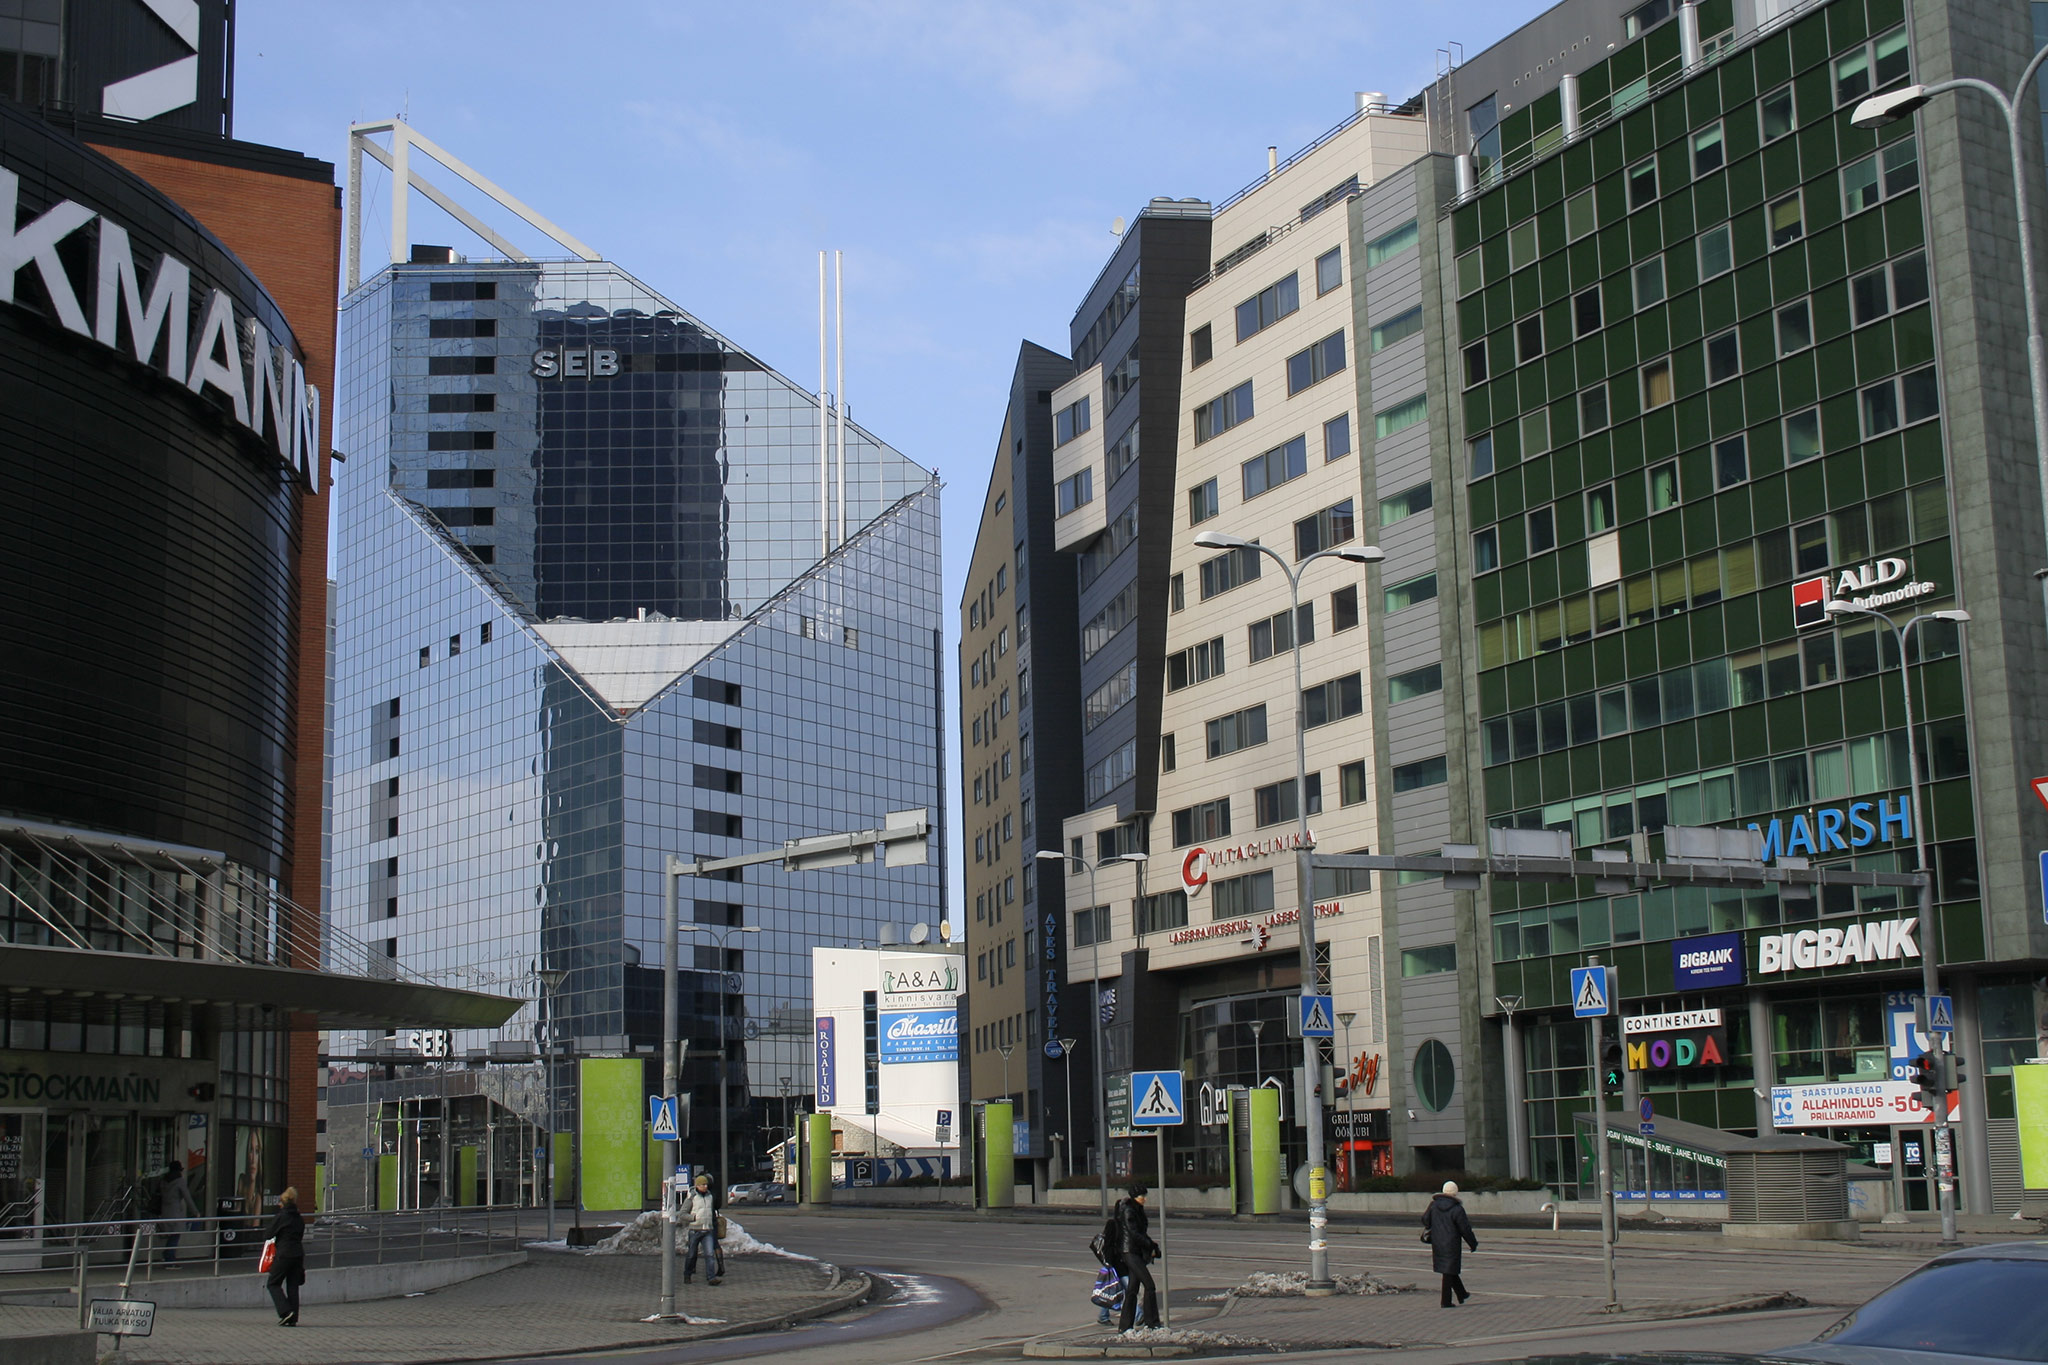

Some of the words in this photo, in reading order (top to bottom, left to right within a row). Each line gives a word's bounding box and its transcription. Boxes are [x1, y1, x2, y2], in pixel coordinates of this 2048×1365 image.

[534, 350, 619, 378] SEB
[1836, 557, 1907, 595] ALD
[1852, 581, 1935, 609] Automotive
[1747, 794, 1914, 862] MARSH
[1209, 829, 1316, 866] VITACLINIKA
[1264, 902, 1343, 926] LASERCTRUM
[1045, 913, 1056, 959] AVES
[1169, 919, 1251, 943] LASERRAVIKESKUS
[1759, 917, 1920, 973] BIGBANK
[1679, 948, 1733, 968] BIGBANK
[885, 993, 957, 1003] kinnisvara
[1046, 969, 1058, 1040] TRAVEL
[887, 1015, 957, 1040] Maxill
[1626, 1012, 1715, 1031] CONTINENTAL
[1628, 1035, 1723, 1070] MODA
[820, 1031, 830, 1103] ROSALIND
[1802, 1097, 1884, 1110] ALLAHINDLUS
[1811, 1110, 1876, 1121] PRILLIRAAMID
[1888, 1096, 1923, 1112] -50
[115, 1307, 152, 1318] ARVATUD
[121, 1318, 148, 1328] TAKSO
